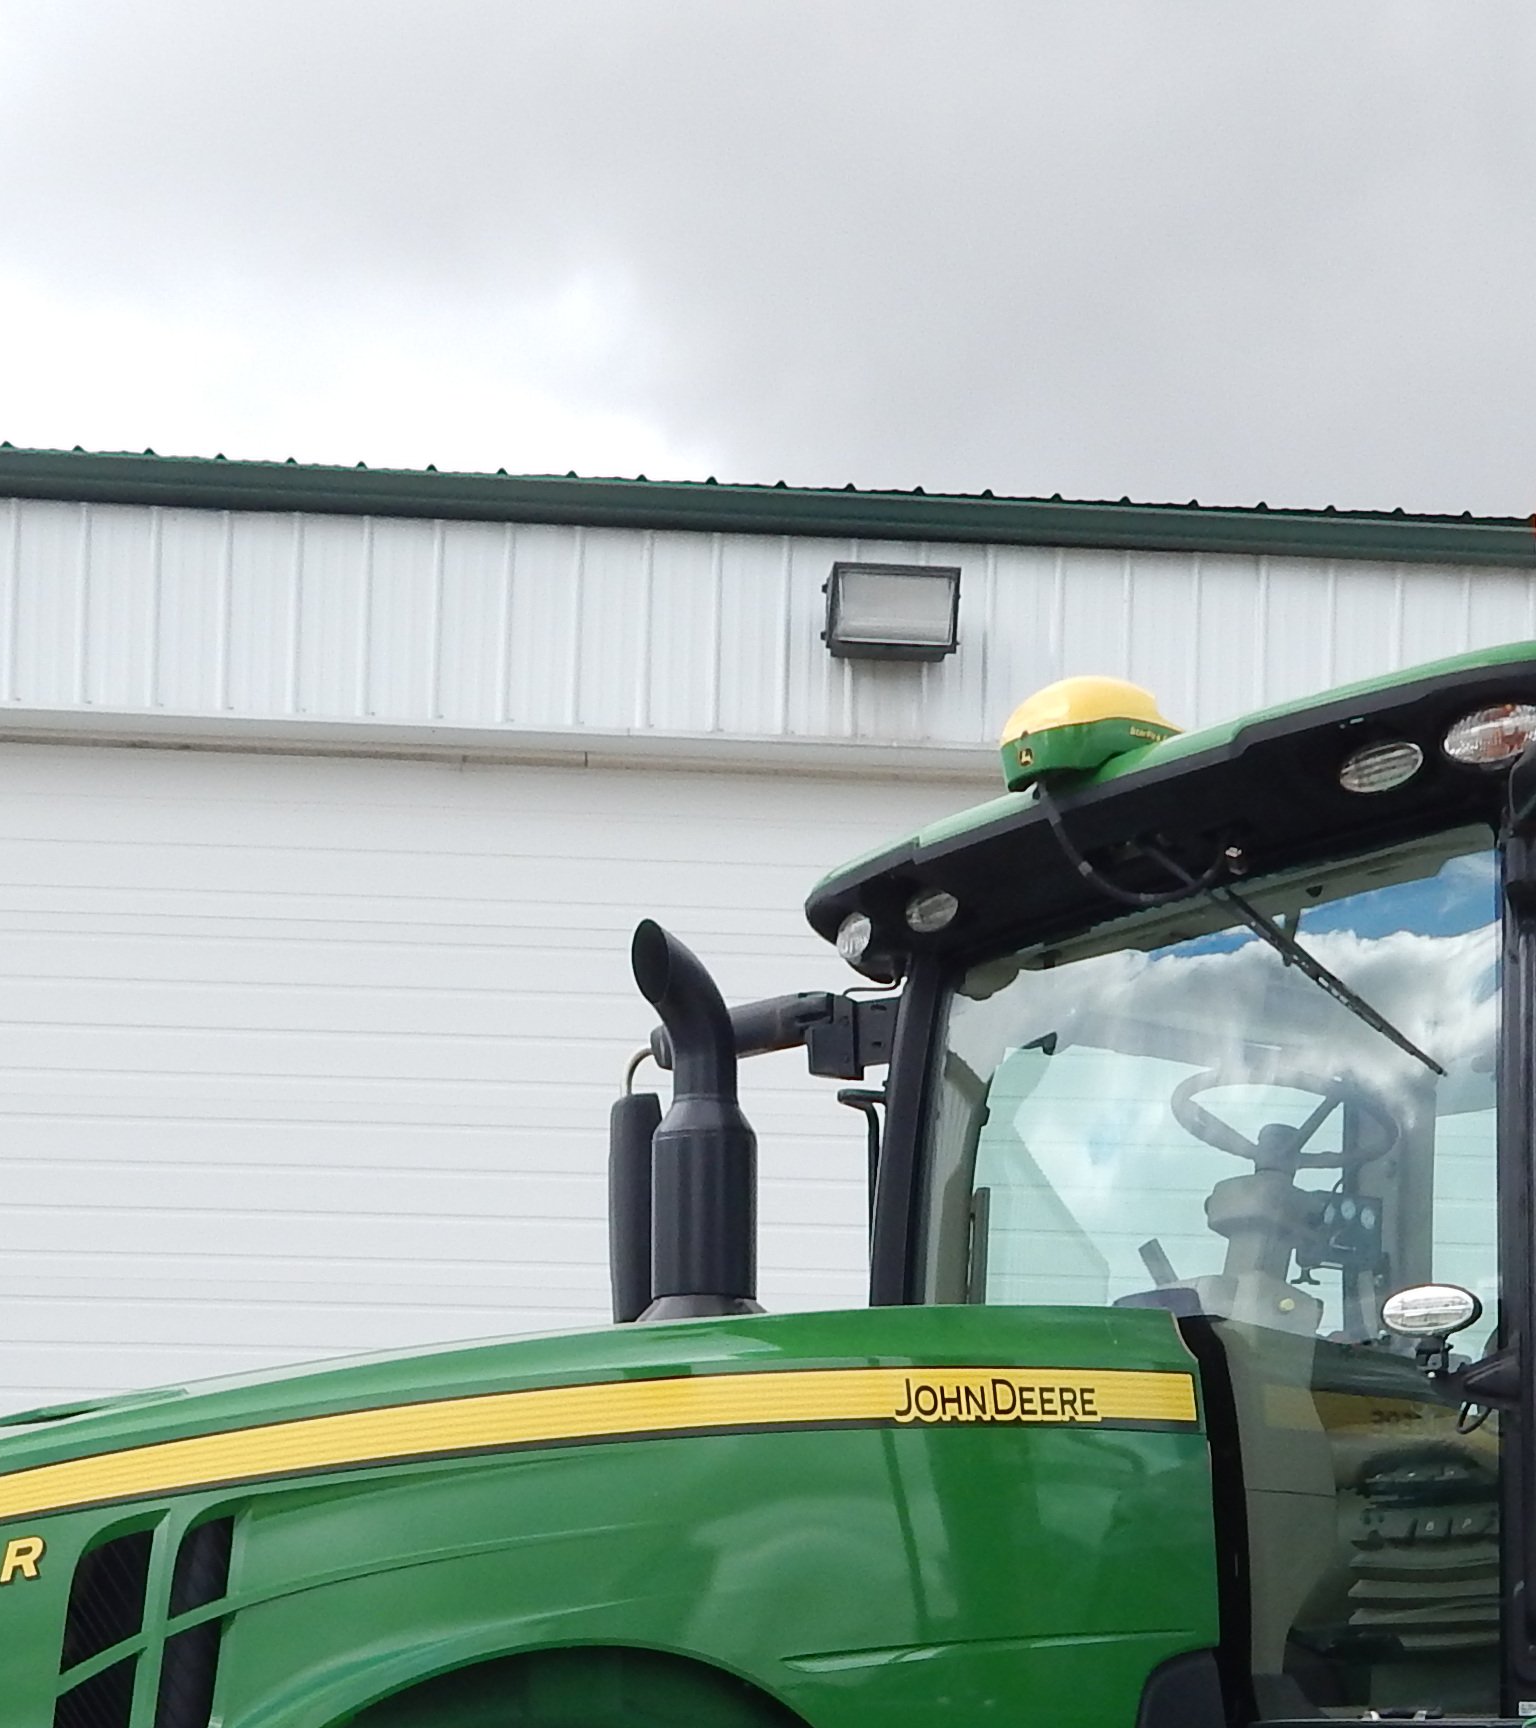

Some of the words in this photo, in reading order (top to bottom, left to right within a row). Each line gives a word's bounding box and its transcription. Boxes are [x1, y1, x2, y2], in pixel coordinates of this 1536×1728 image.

[895, 1378, 985, 1416] JOHN
[992, 1378, 1098, 1416] DEERE
[0, 1536, 46, 1585] R
